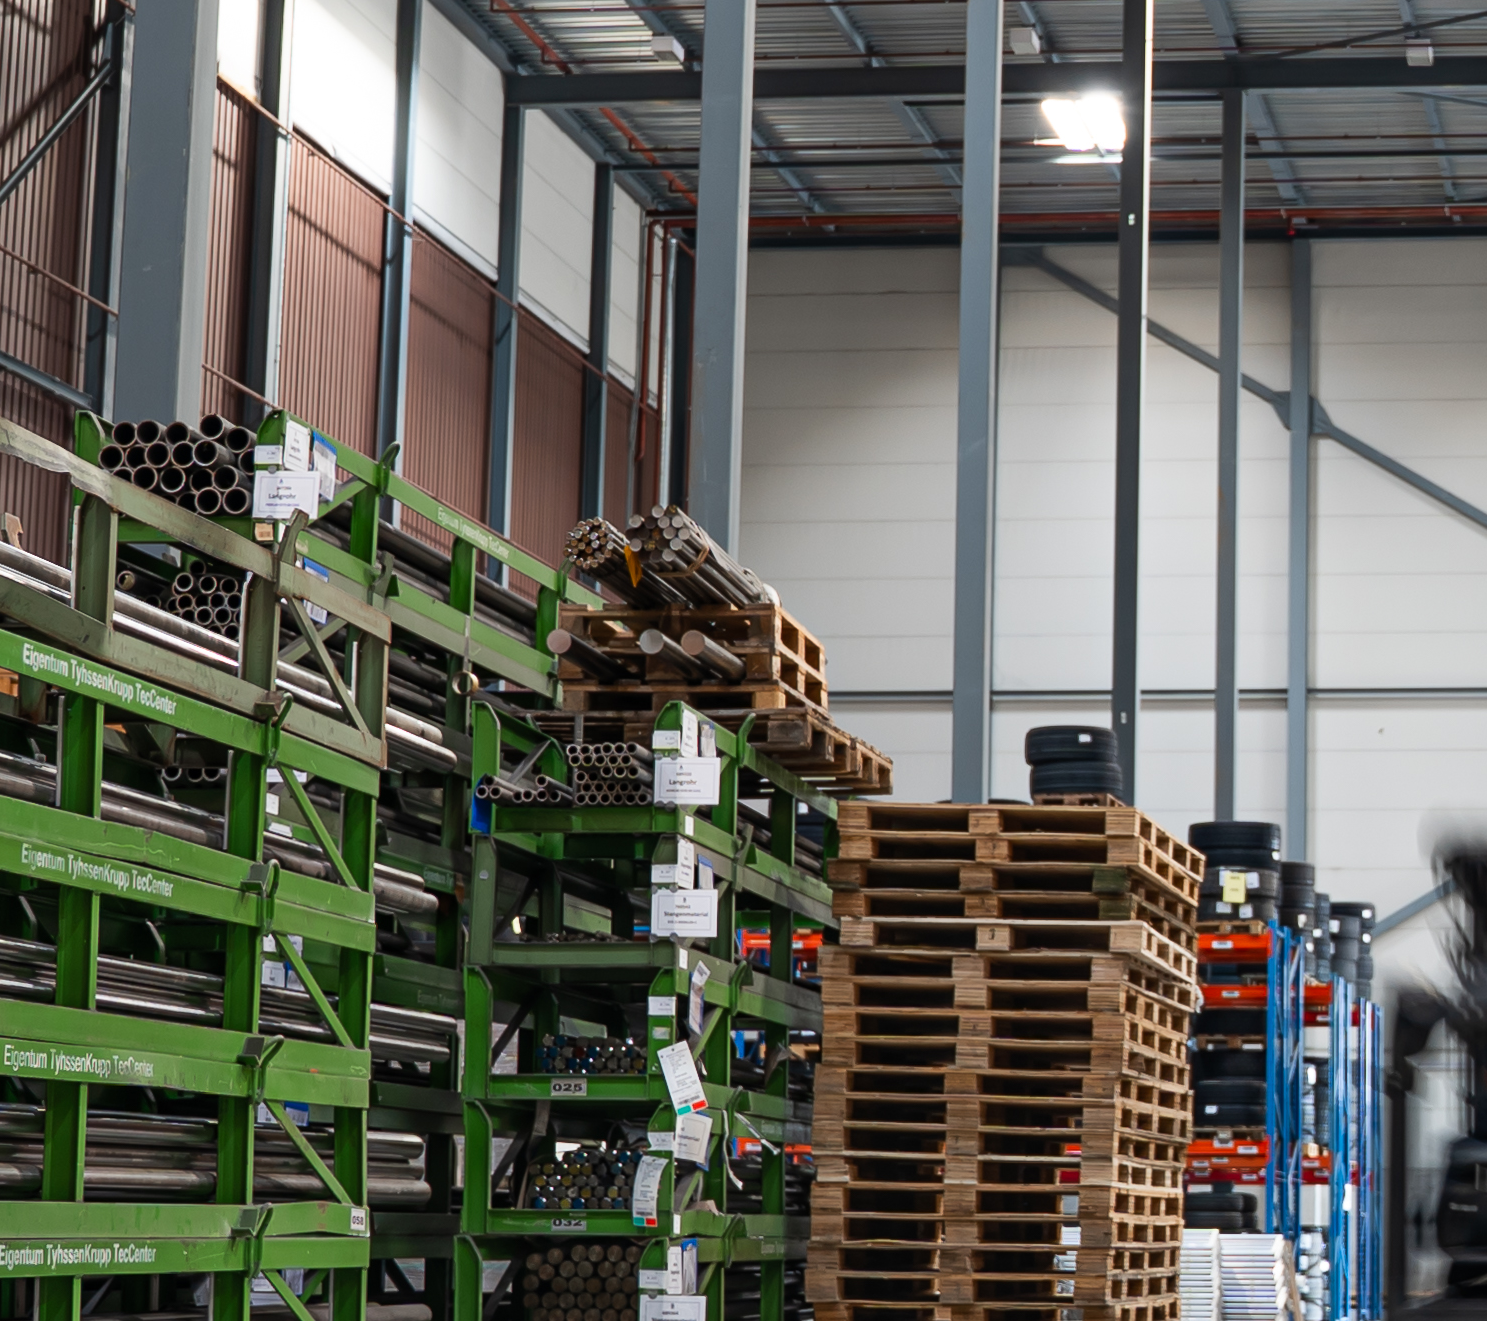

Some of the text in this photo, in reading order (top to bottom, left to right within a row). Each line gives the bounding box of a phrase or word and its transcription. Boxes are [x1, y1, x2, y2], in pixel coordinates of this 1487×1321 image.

[22, 642, 178, 716] Eigentum TyhssenKrupp TecCenter
[668, 779, 698, 787] Langrohr
[21, 842, 174, 898] Eigentum TyhssenKrupp TecCenter
[663, 910, 709, 918] Stangenmaterial
[3, 1043, 154, 1079] Eigentum TyhssenKrupp TecCenter
[552, 1082, 583, 1093] 025
[351, 1215, 365, 1226] 058
[552, 1218, 583, 1227] 032
[45, 1243, 113, 1270] TyhssenKrupp
[113, 1242, 157, 1264] TecCenter
